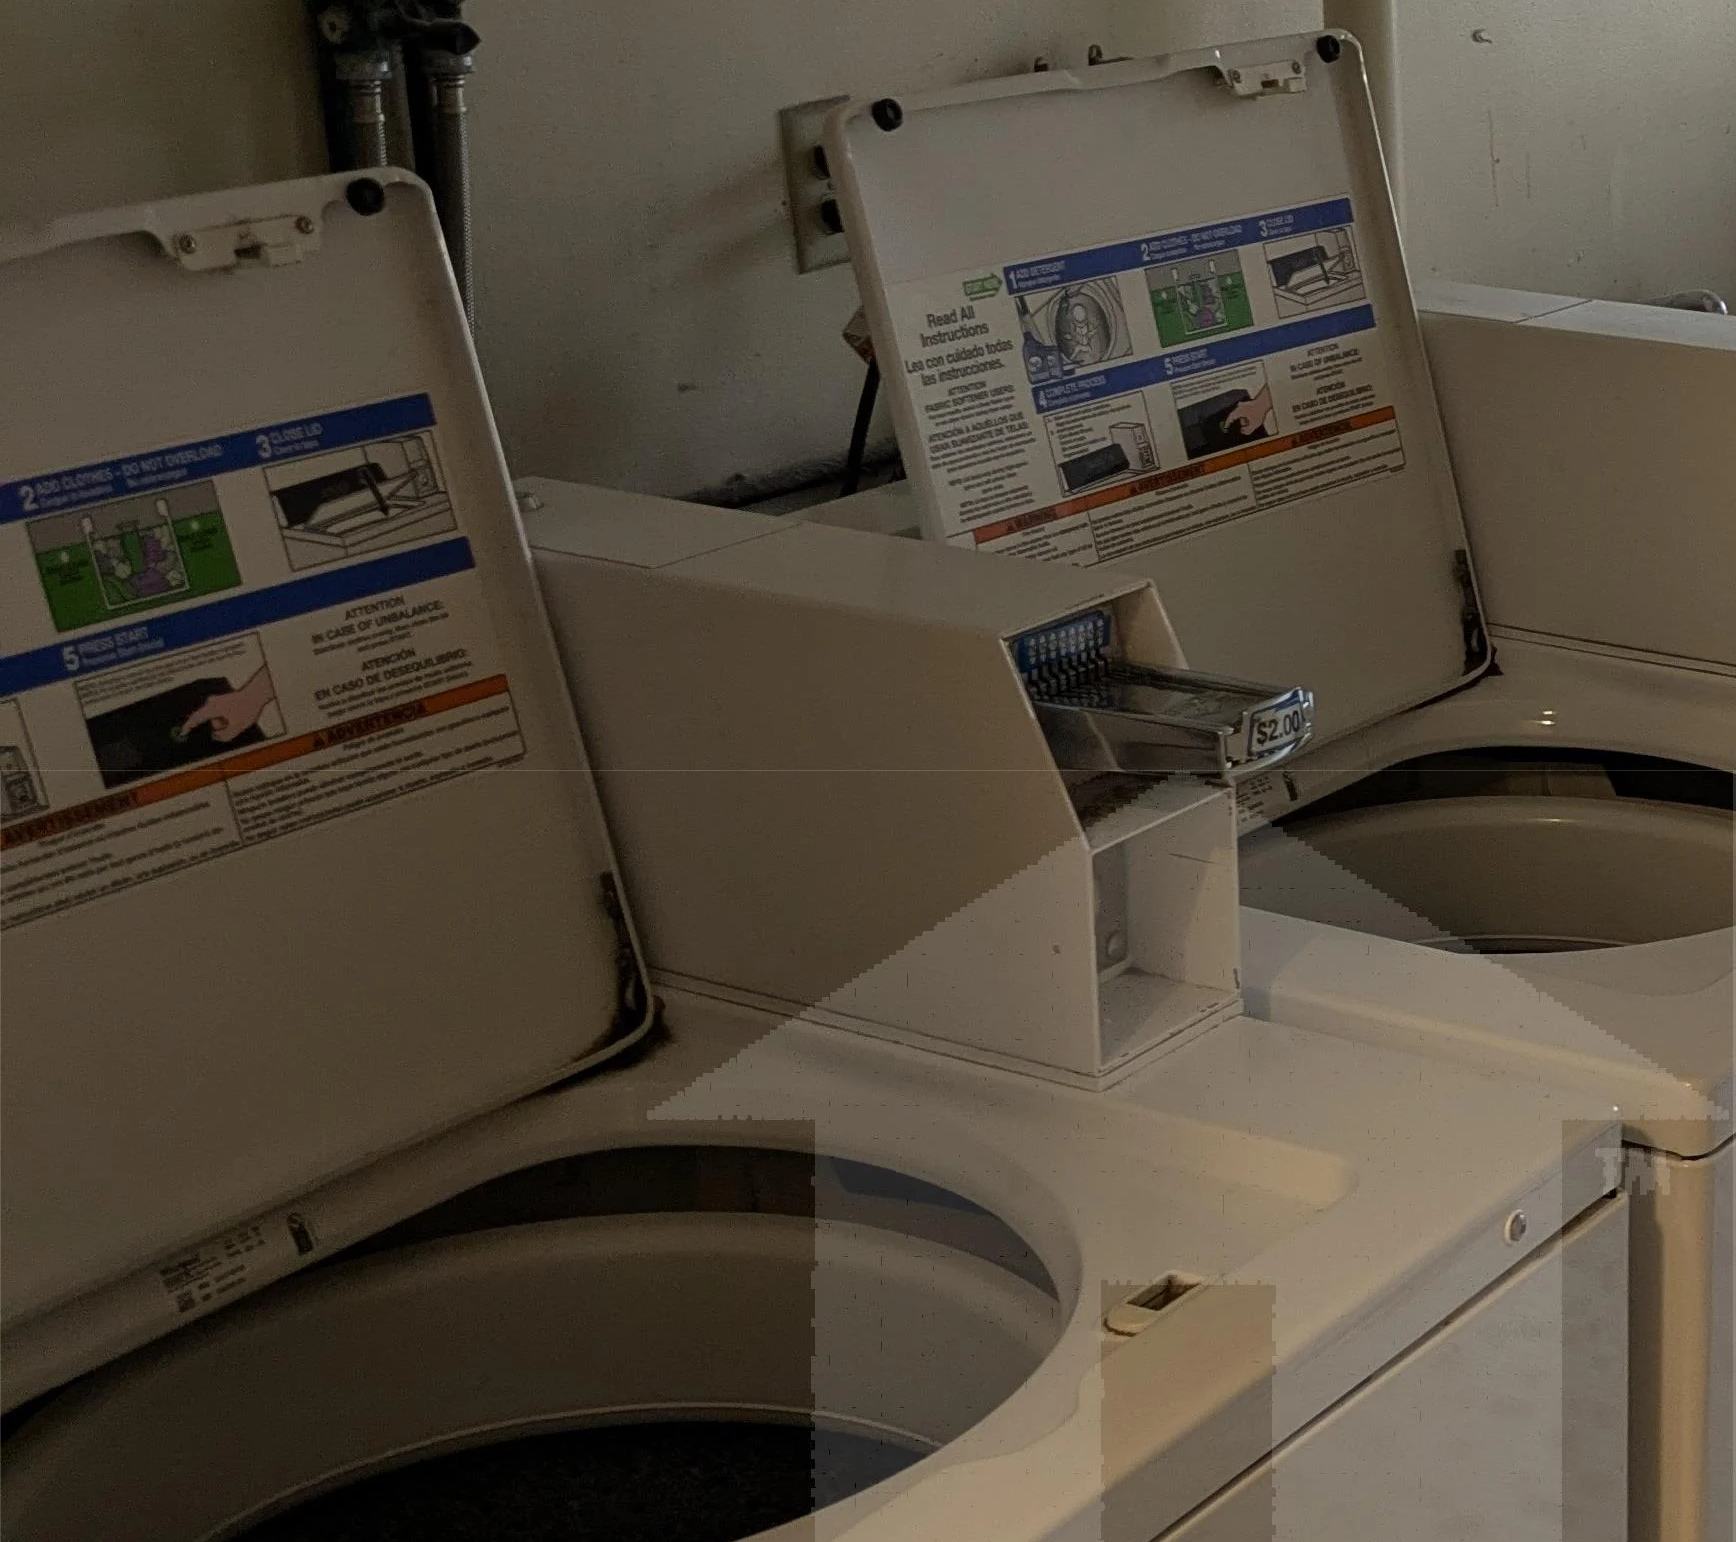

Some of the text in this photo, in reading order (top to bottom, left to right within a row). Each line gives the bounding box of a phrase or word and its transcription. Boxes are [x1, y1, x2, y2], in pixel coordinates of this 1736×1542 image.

[1259, 220, 1268, 238] 3
[1140, 245, 1151, 262] 2
[1008, 269, 1018, 289] 1
[926, 305, 975, 328] Read All
[920, 322, 989, 347] Instructions
[947, 344, 984, 364] cuidado
[986, 339, 1013, 353] todas
[1164, 358, 1174, 375] 5
[255, 435, 272, 459] 3
[18, 485, 39, 512] 2
[345, 595, 405, 620] ATTENTION
[326, 623, 356, 641] CASE
[357, 620, 372, 631] OF
[61, 646, 80, 671] 5
[314, 688, 331, 701] EN
[332, 678, 364, 695] CASO
[365, 673, 381, 685] DE
[1257, 710, 1299, 747] $2.00
